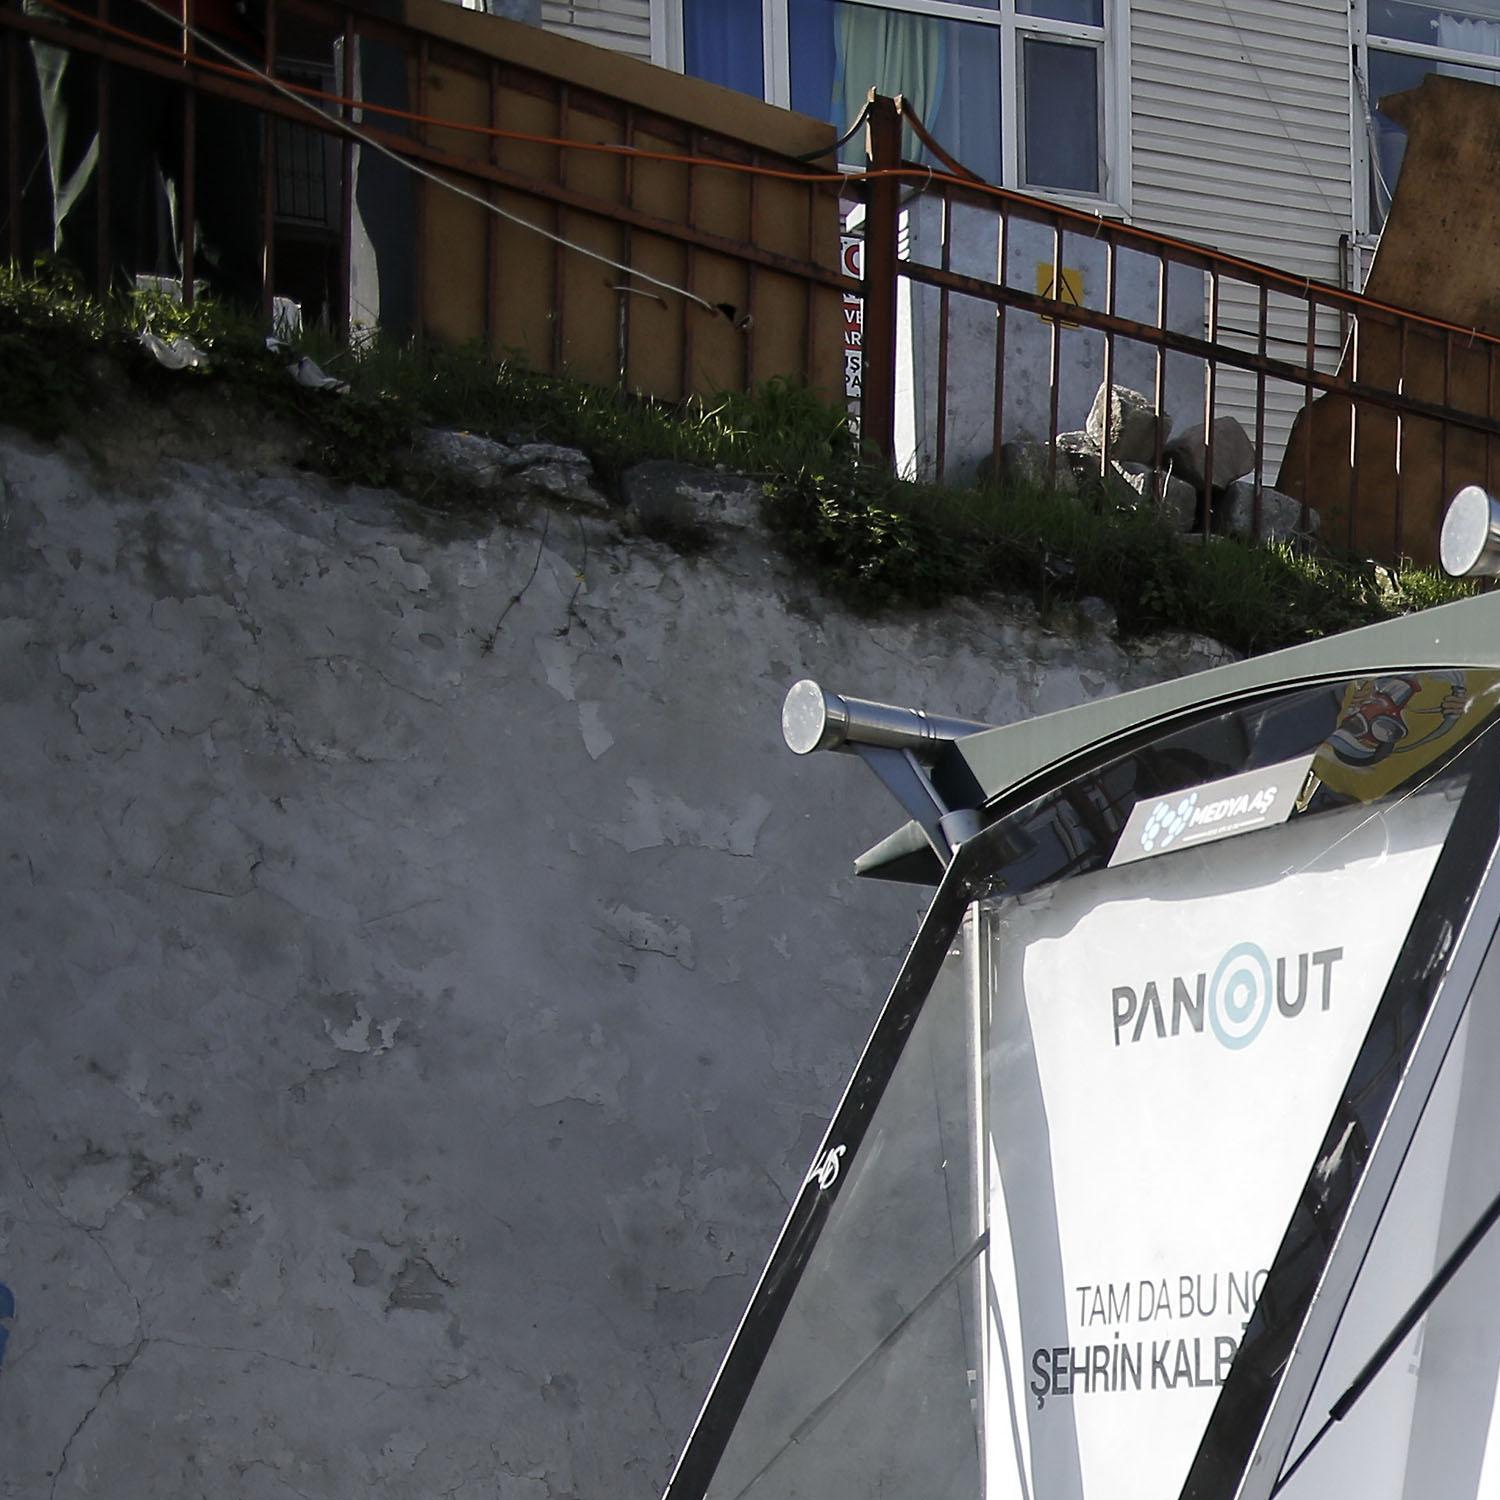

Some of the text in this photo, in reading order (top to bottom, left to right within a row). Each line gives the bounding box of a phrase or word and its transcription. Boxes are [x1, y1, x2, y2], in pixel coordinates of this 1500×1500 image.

[1112, 941, 1344, 1050] PANOUT
[1076, 1282, 1130, 1327] TAM
[1138, 1278, 1172, 1322] DA
[1179, 1273, 1218, 1318] BU
[1031, 1322, 1249, 1410] ŞEHRİN KALB
